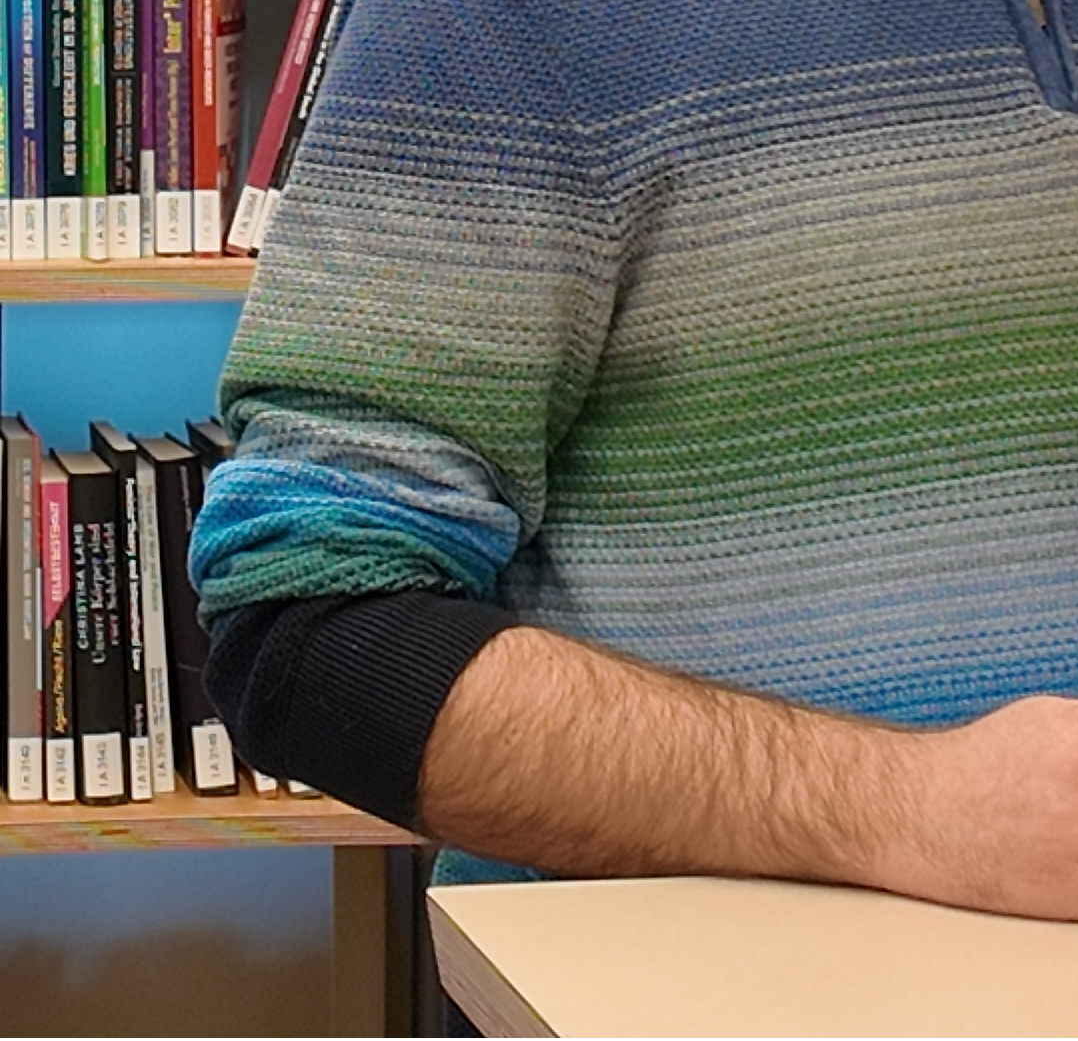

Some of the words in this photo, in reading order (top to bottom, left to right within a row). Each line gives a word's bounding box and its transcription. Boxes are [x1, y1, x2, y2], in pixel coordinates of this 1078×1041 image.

[73, 523, 86, 565] LAMB
[88, 523, 102, 554] sind
[90, 557, 106, 610] Körper
[103, 523, 119, 610] Schlachtfeld
[74, 569, 91, 650] CHRISTINA
[107, 614, 120, 646] euer
[91, 613, 107, 665] Unsere
